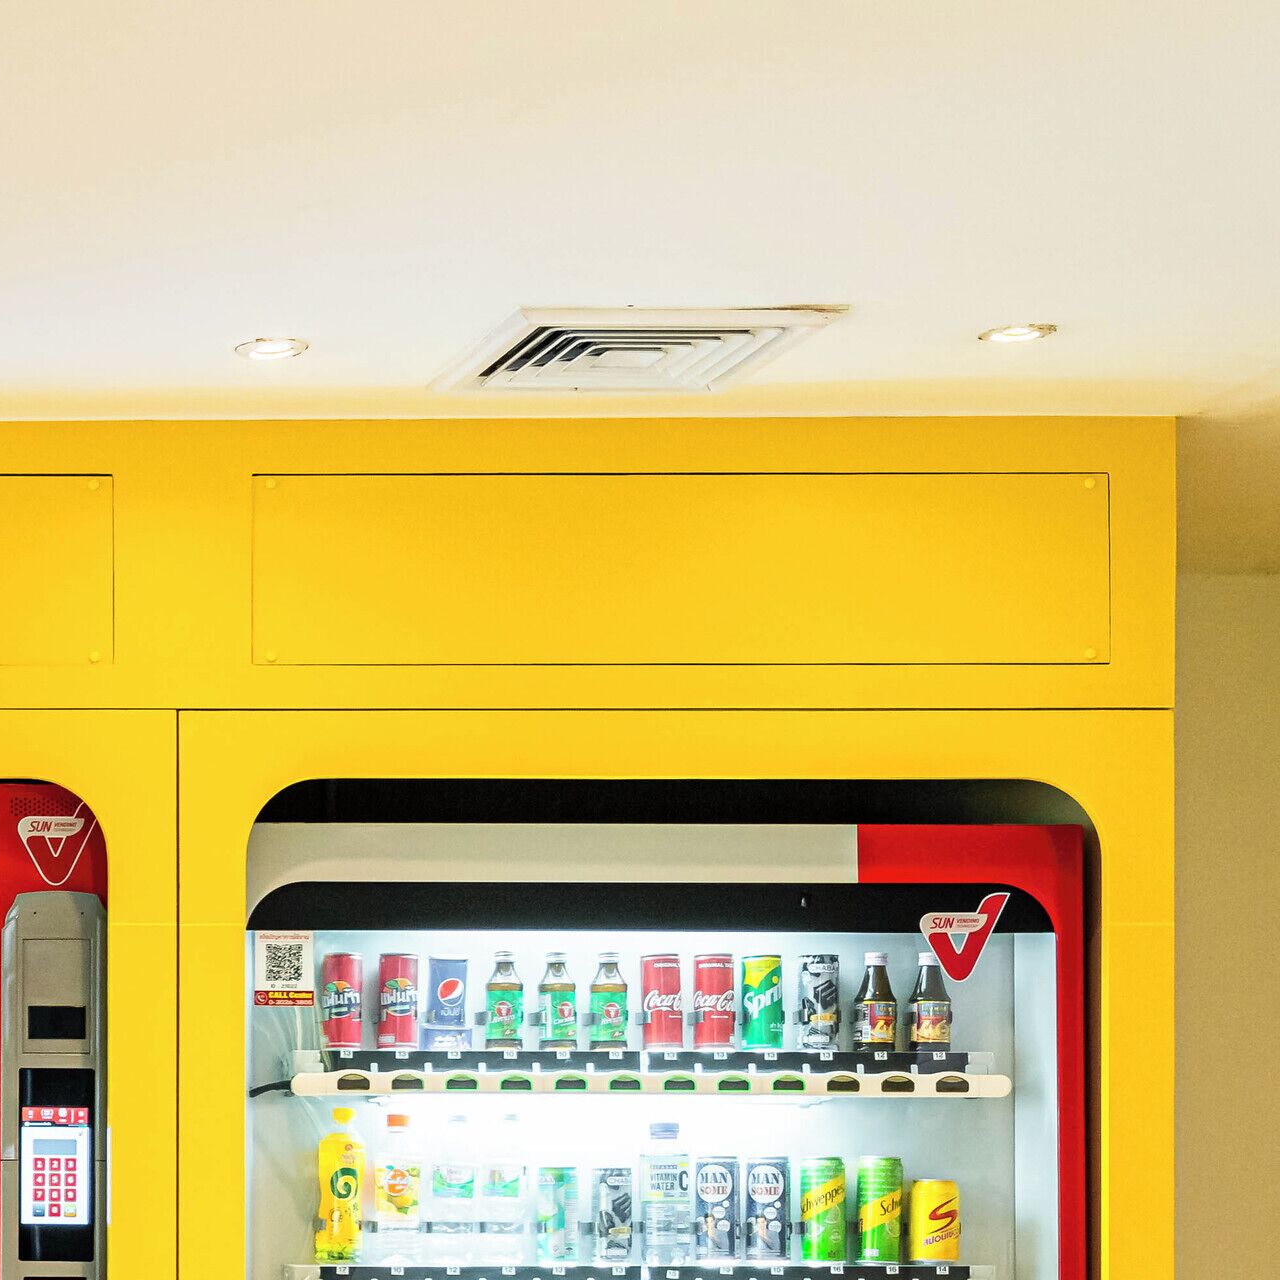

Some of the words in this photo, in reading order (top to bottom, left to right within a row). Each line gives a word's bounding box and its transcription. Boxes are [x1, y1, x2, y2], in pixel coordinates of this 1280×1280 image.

[28, 821, 52, 832] SUN
[930, 917, 955, 929] SUN
[650, 1172, 677, 1182] VITAMIN
[678, 1170, 689, 1192] C
[700, 1173, 729, 1184] MAN
[751, 1173, 780, 1185] MAN
[650, 1182, 675, 1191] WATER
[700, 1186, 728, 1195] SOME
[751, 1186, 780, 1196] SOME
